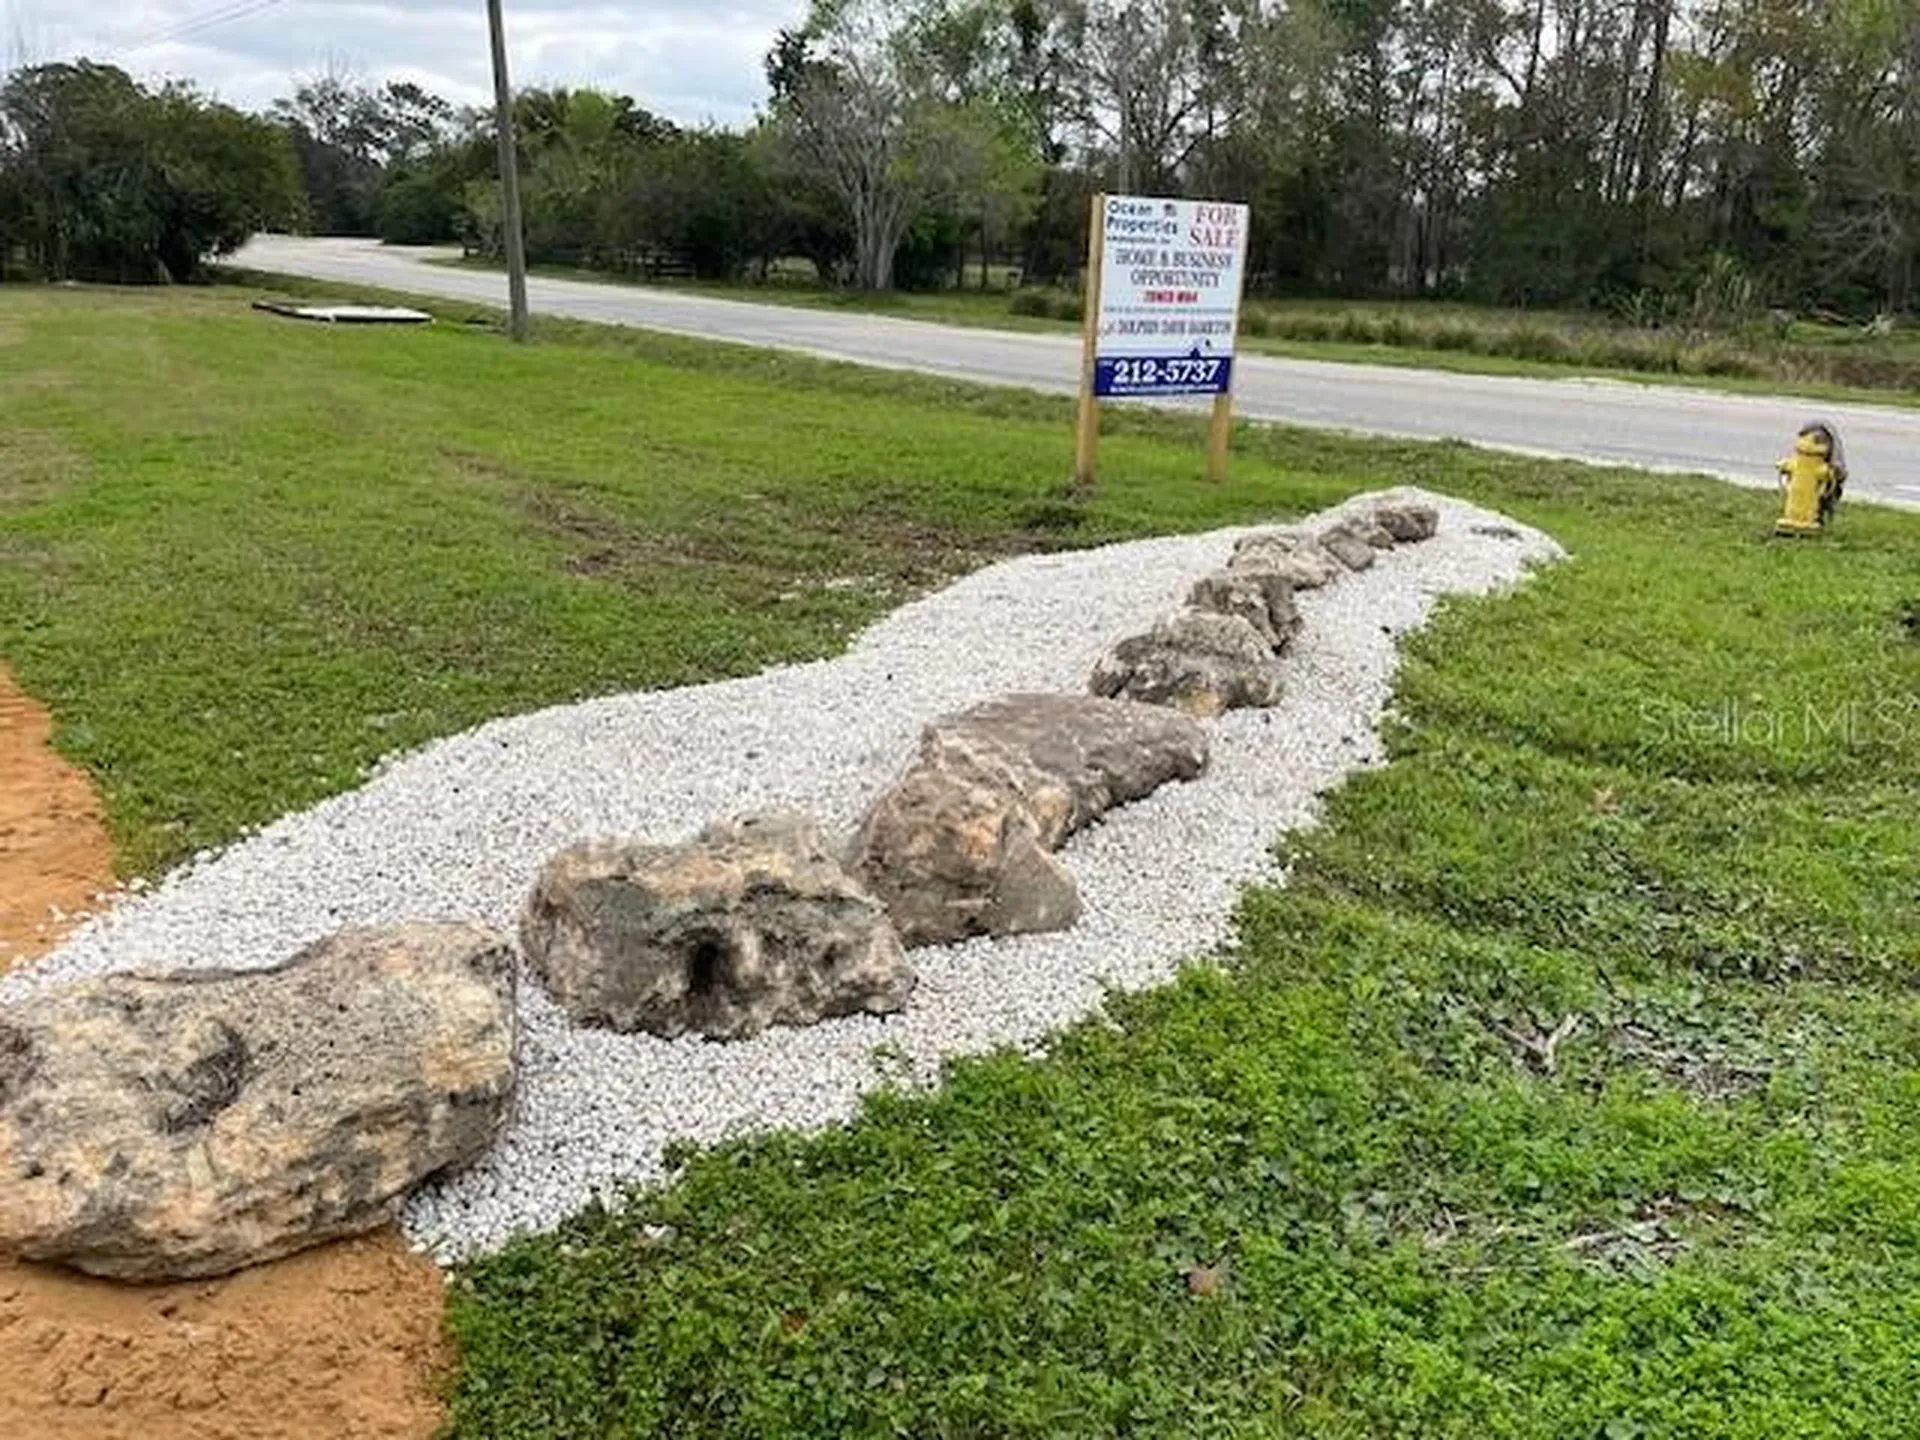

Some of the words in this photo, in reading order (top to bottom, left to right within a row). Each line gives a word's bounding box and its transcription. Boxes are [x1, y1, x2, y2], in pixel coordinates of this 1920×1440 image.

[1108, 201, 1152, 214] Ocean
[1197, 206, 1237, 226] FOR
[1107, 216, 1178, 235] Properties
[1190, 229, 1238, 247] SALE
[1130, 269, 1220, 287] OPPORTUNITY
[1113, 360, 1220, 383] 212-5737
